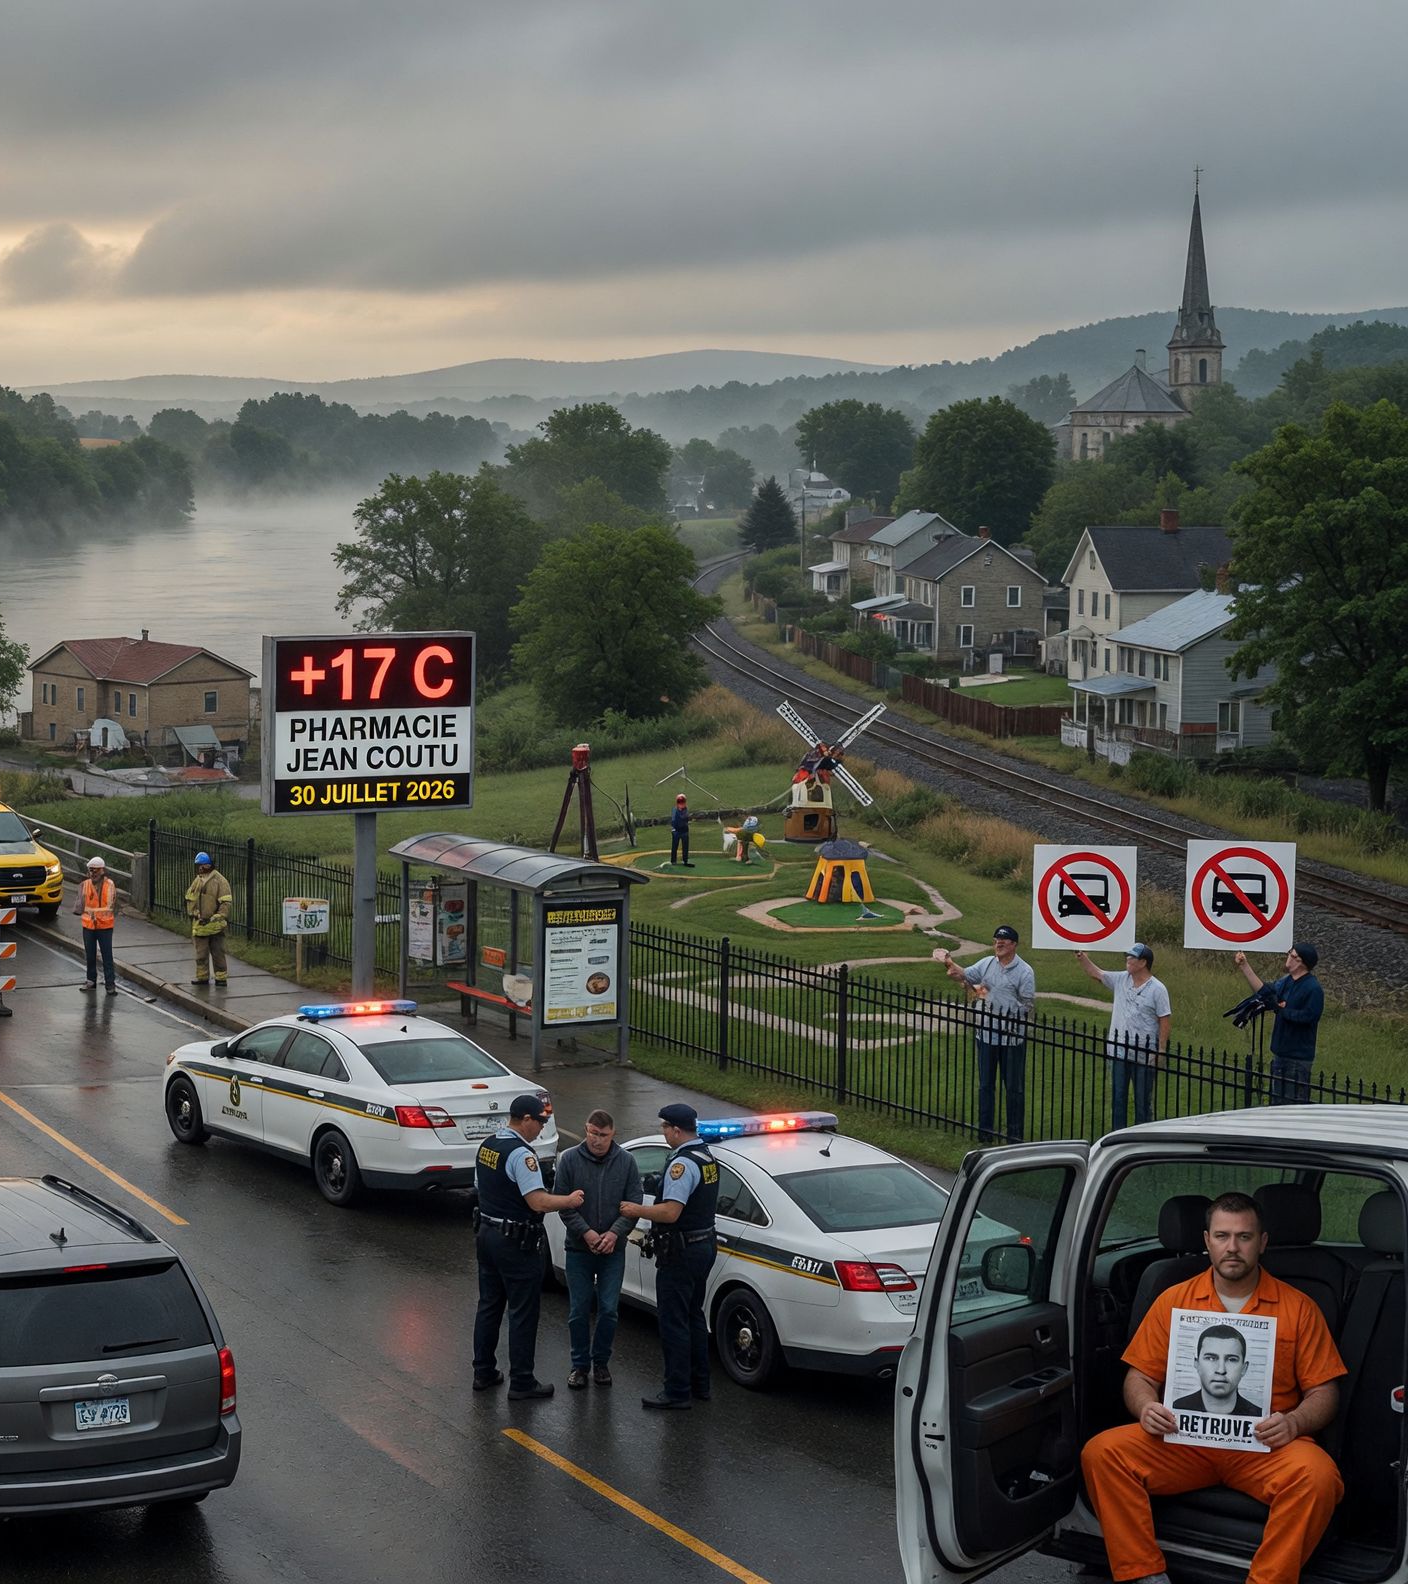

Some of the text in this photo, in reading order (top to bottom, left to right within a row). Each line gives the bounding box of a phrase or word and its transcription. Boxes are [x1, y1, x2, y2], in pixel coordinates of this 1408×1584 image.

[290, 645, 454, 700] +17 C
[290, 714, 457, 742] PHARMACIE
[286, 743, 458, 773] JEAN COUTU
[290, 780, 455, 805] 30 JUILLET 2026
[1179, 1414, 1253, 1438] RETRUVE
